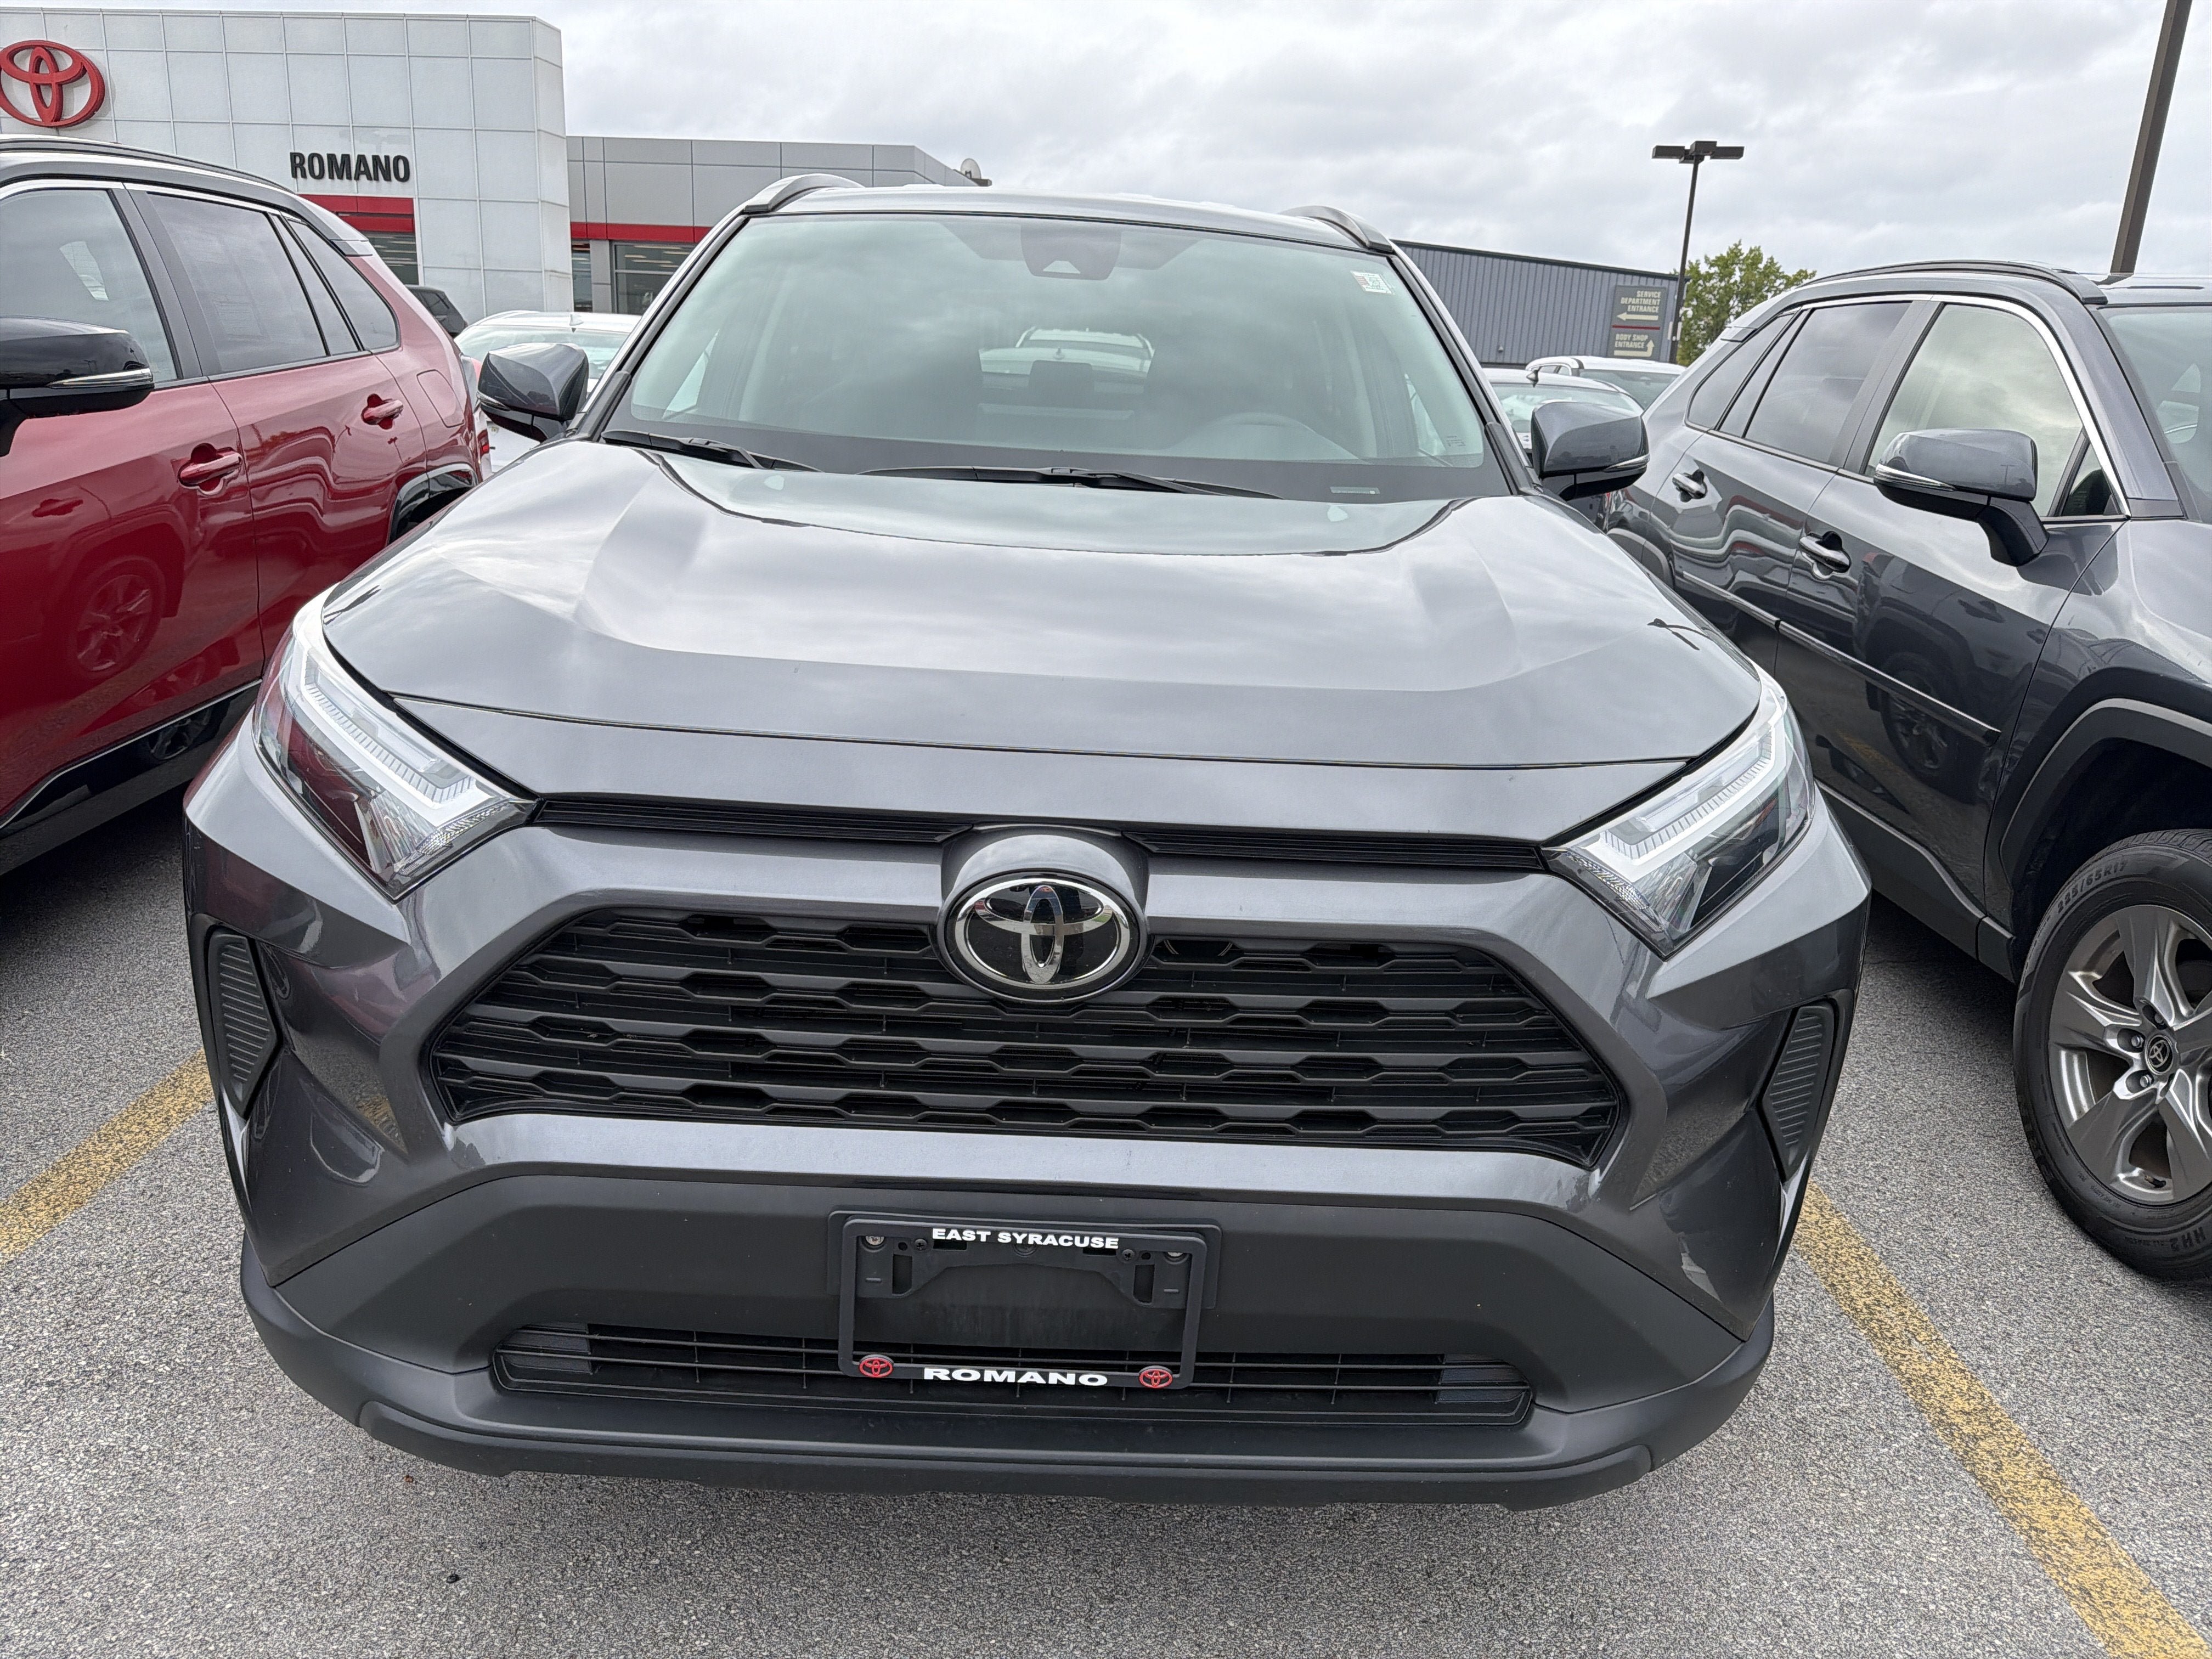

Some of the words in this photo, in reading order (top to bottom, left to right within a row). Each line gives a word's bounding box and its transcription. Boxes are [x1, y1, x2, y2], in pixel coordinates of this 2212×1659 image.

[290, 152, 410, 183] ROMANO
[1621, 297, 1660, 305] DEPARTMENT
[933, 1228, 991, 1242] EAST
[997, 1232, 1119, 1249] SYRACUSE
[923, 1368, 1108, 1386] ROMANO
